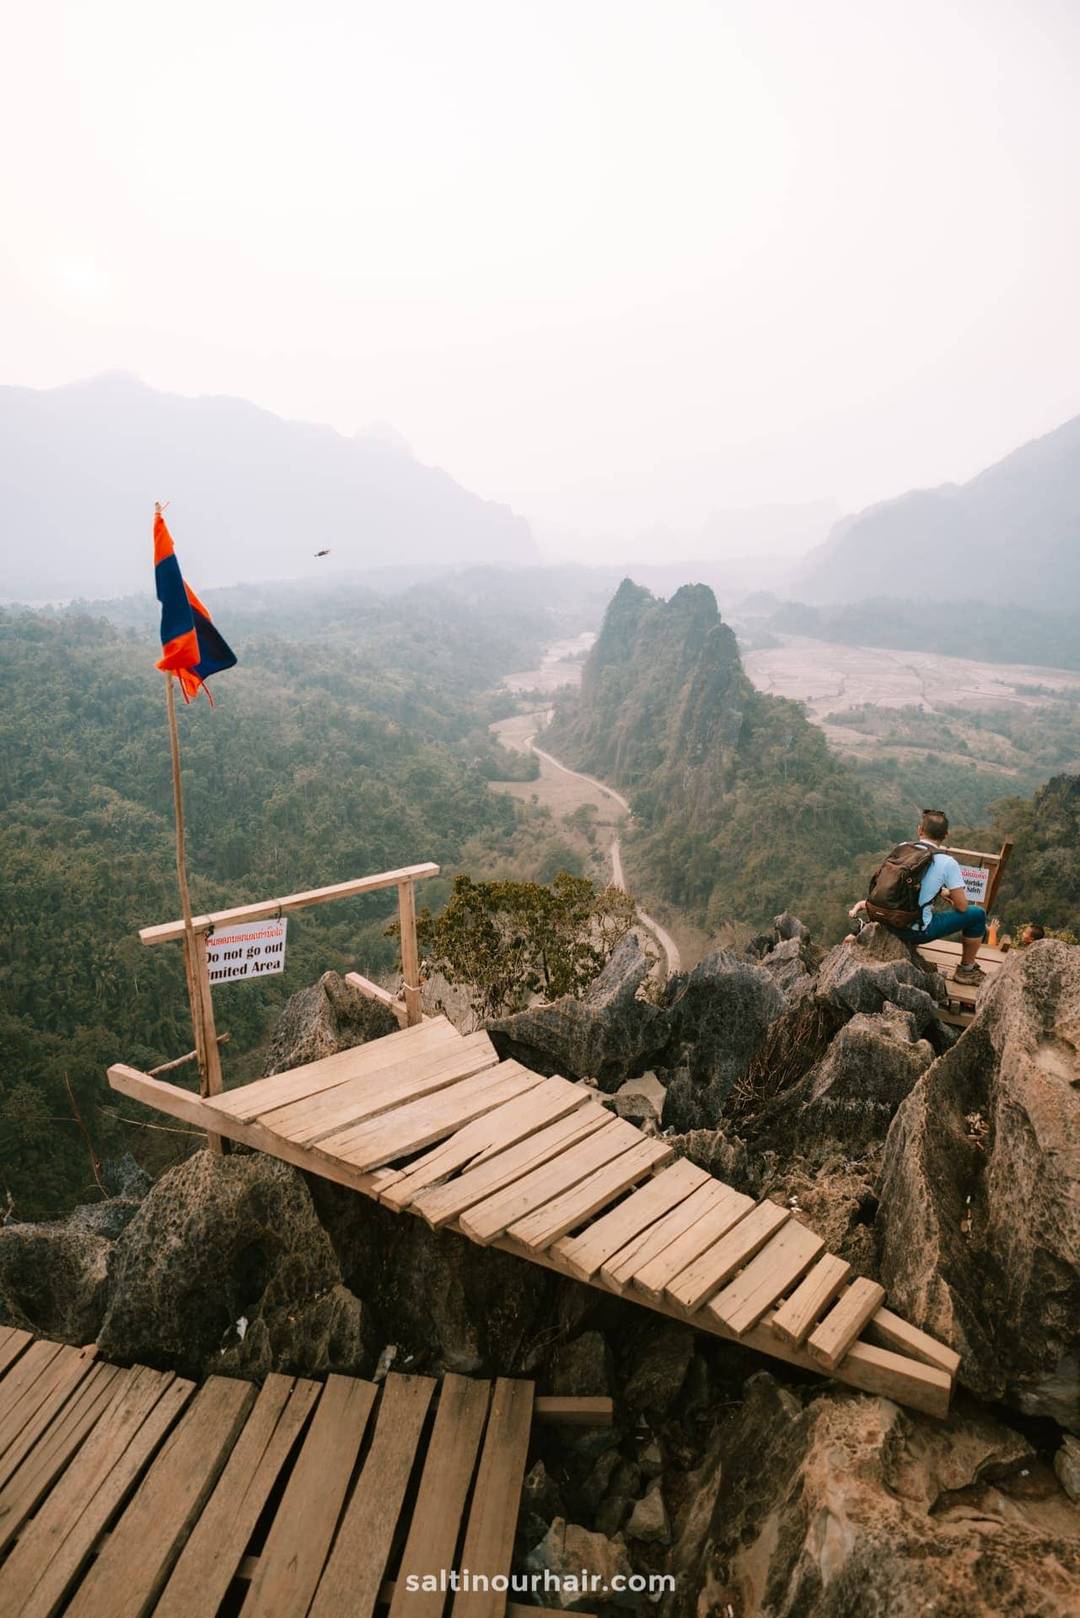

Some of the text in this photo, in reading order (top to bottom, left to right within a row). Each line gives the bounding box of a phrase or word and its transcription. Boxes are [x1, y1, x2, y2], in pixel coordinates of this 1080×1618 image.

[224, 948, 243, 960] not
[246, 946, 261, 959] go
[264, 942, 283, 954] out
[208, 960, 280, 980] imited Area
